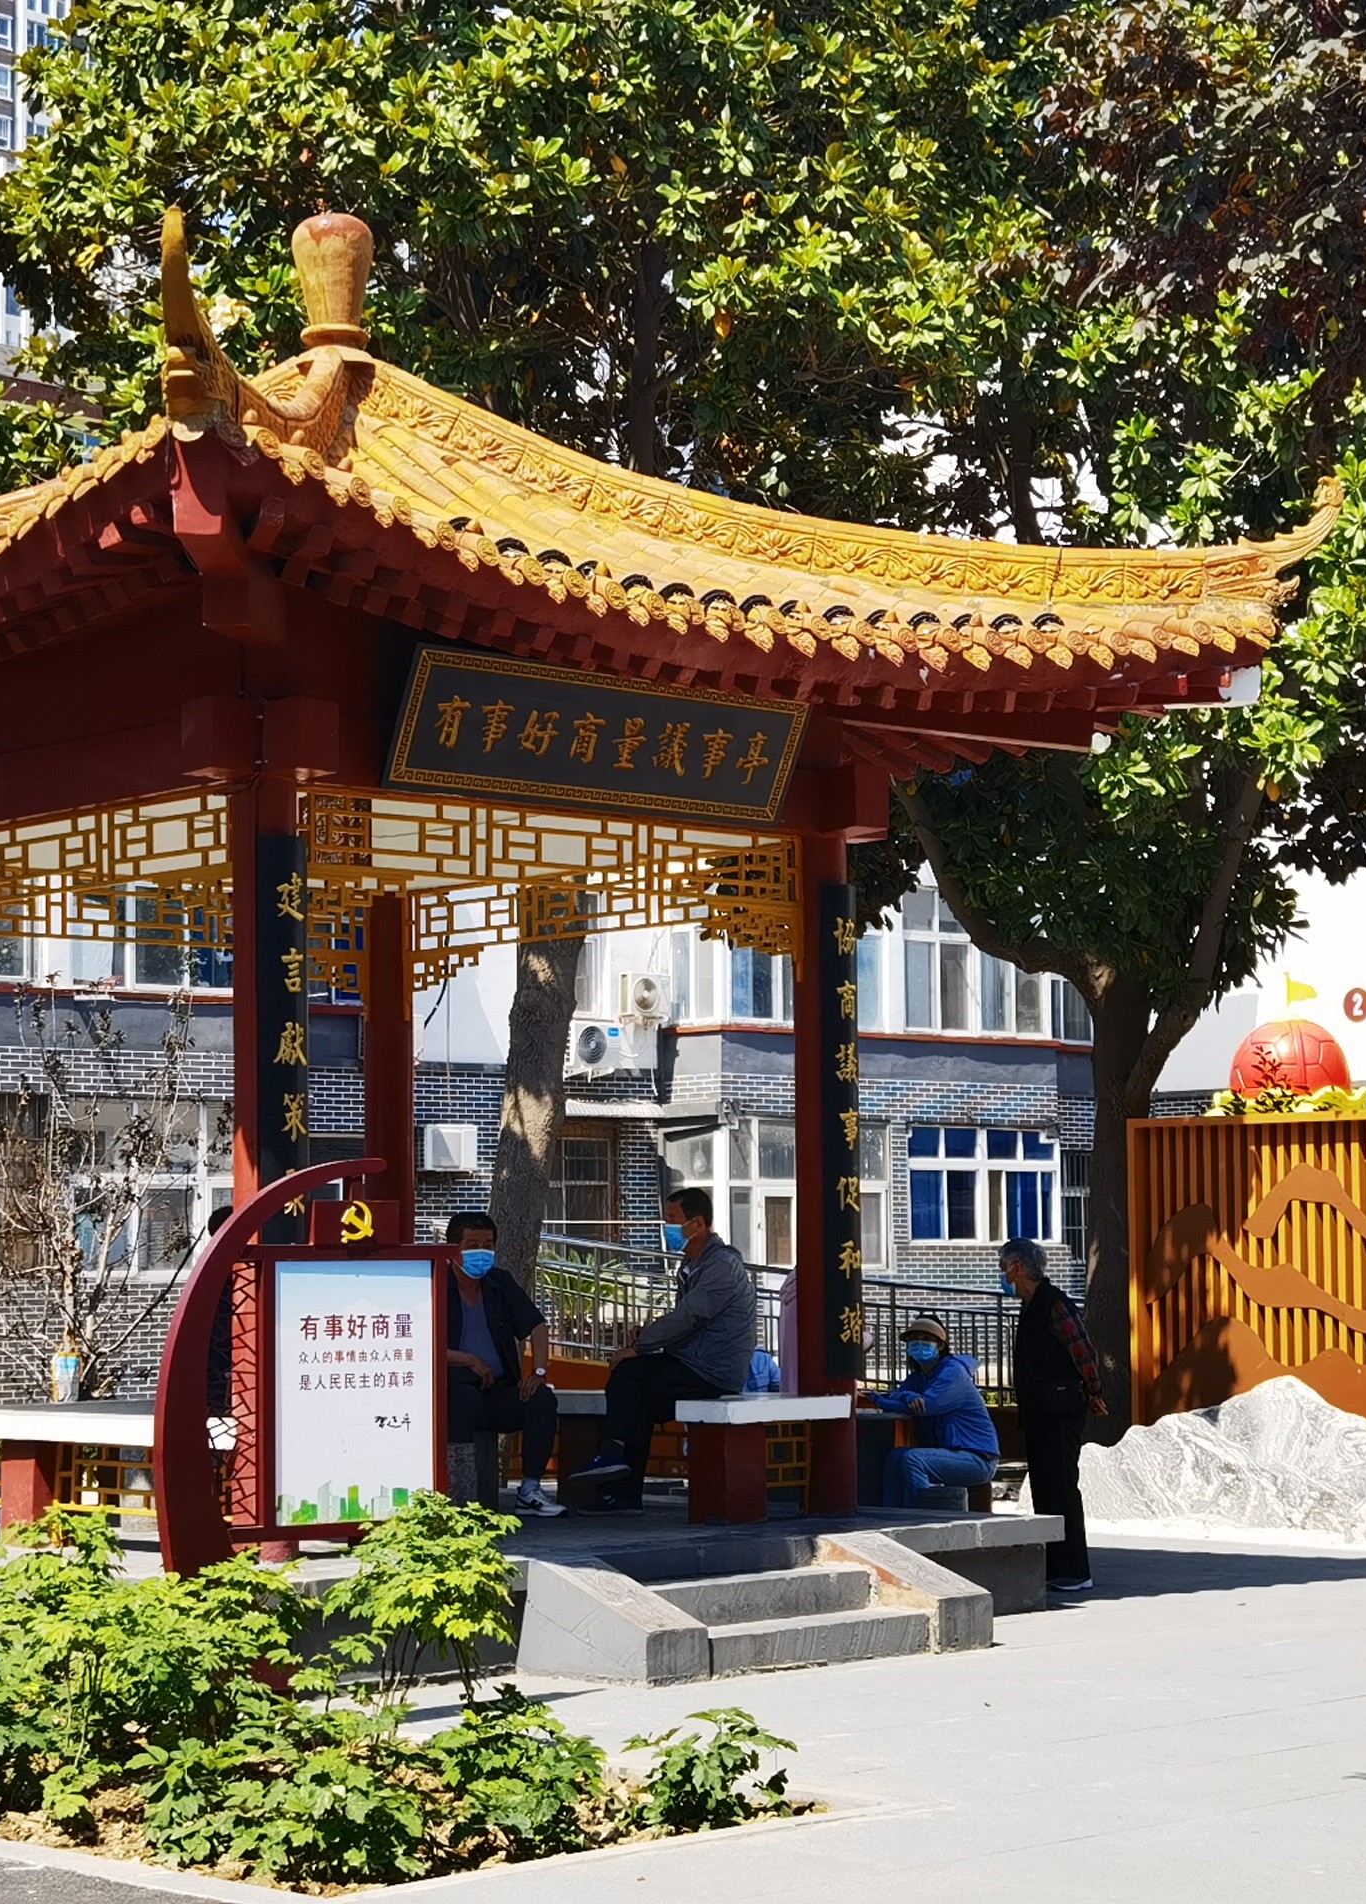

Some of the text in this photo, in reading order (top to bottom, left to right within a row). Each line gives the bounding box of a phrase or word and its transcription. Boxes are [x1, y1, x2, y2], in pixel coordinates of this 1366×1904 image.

[434, 694, 770, 786] 有事好商量議事亭
[1351, 992, 1364, 1017] 2
[299, 1313, 414, 1341] 有事好商量
[298, 1348, 415, 1364] 众人的事情由众人商量
[298, 1371, 415, 1391] 是人民民主的真谛
